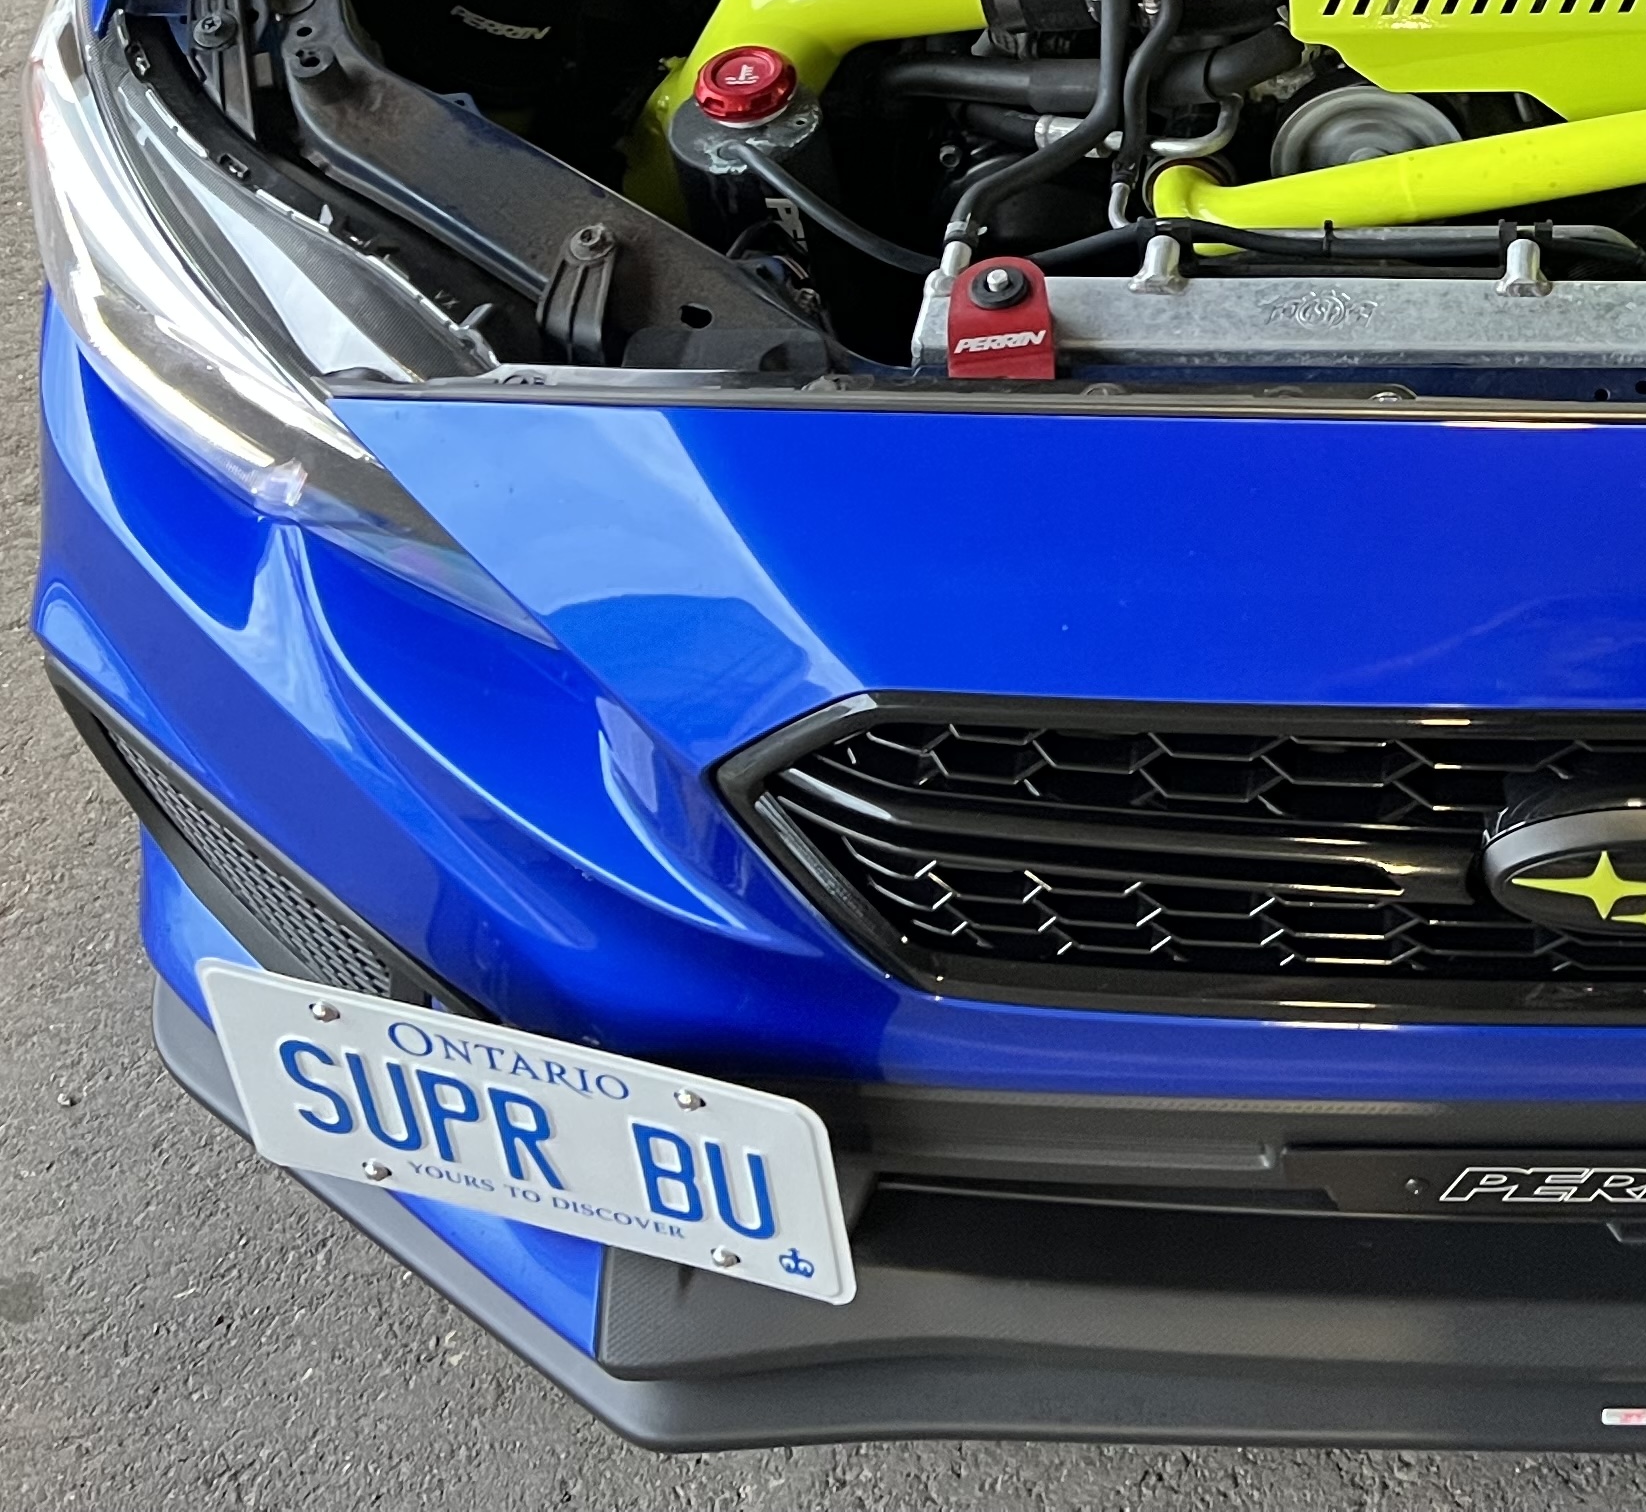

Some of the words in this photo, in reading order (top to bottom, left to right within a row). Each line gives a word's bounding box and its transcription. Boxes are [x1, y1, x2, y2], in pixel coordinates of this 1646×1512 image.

[450, 5, 551, 39] PERRIN
[954, 330, 1047, 354] PERRIN
[387, 1022, 629, 1101] ONTARIO
[279, 1039, 566, 1190] SUPR
[632, 1122, 777, 1239] BU
[407, 1160, 496, 1193] YOURS
[503, 1184, 541, 1204] TO
[552, 1196, 686, 1239] DISCOVER
